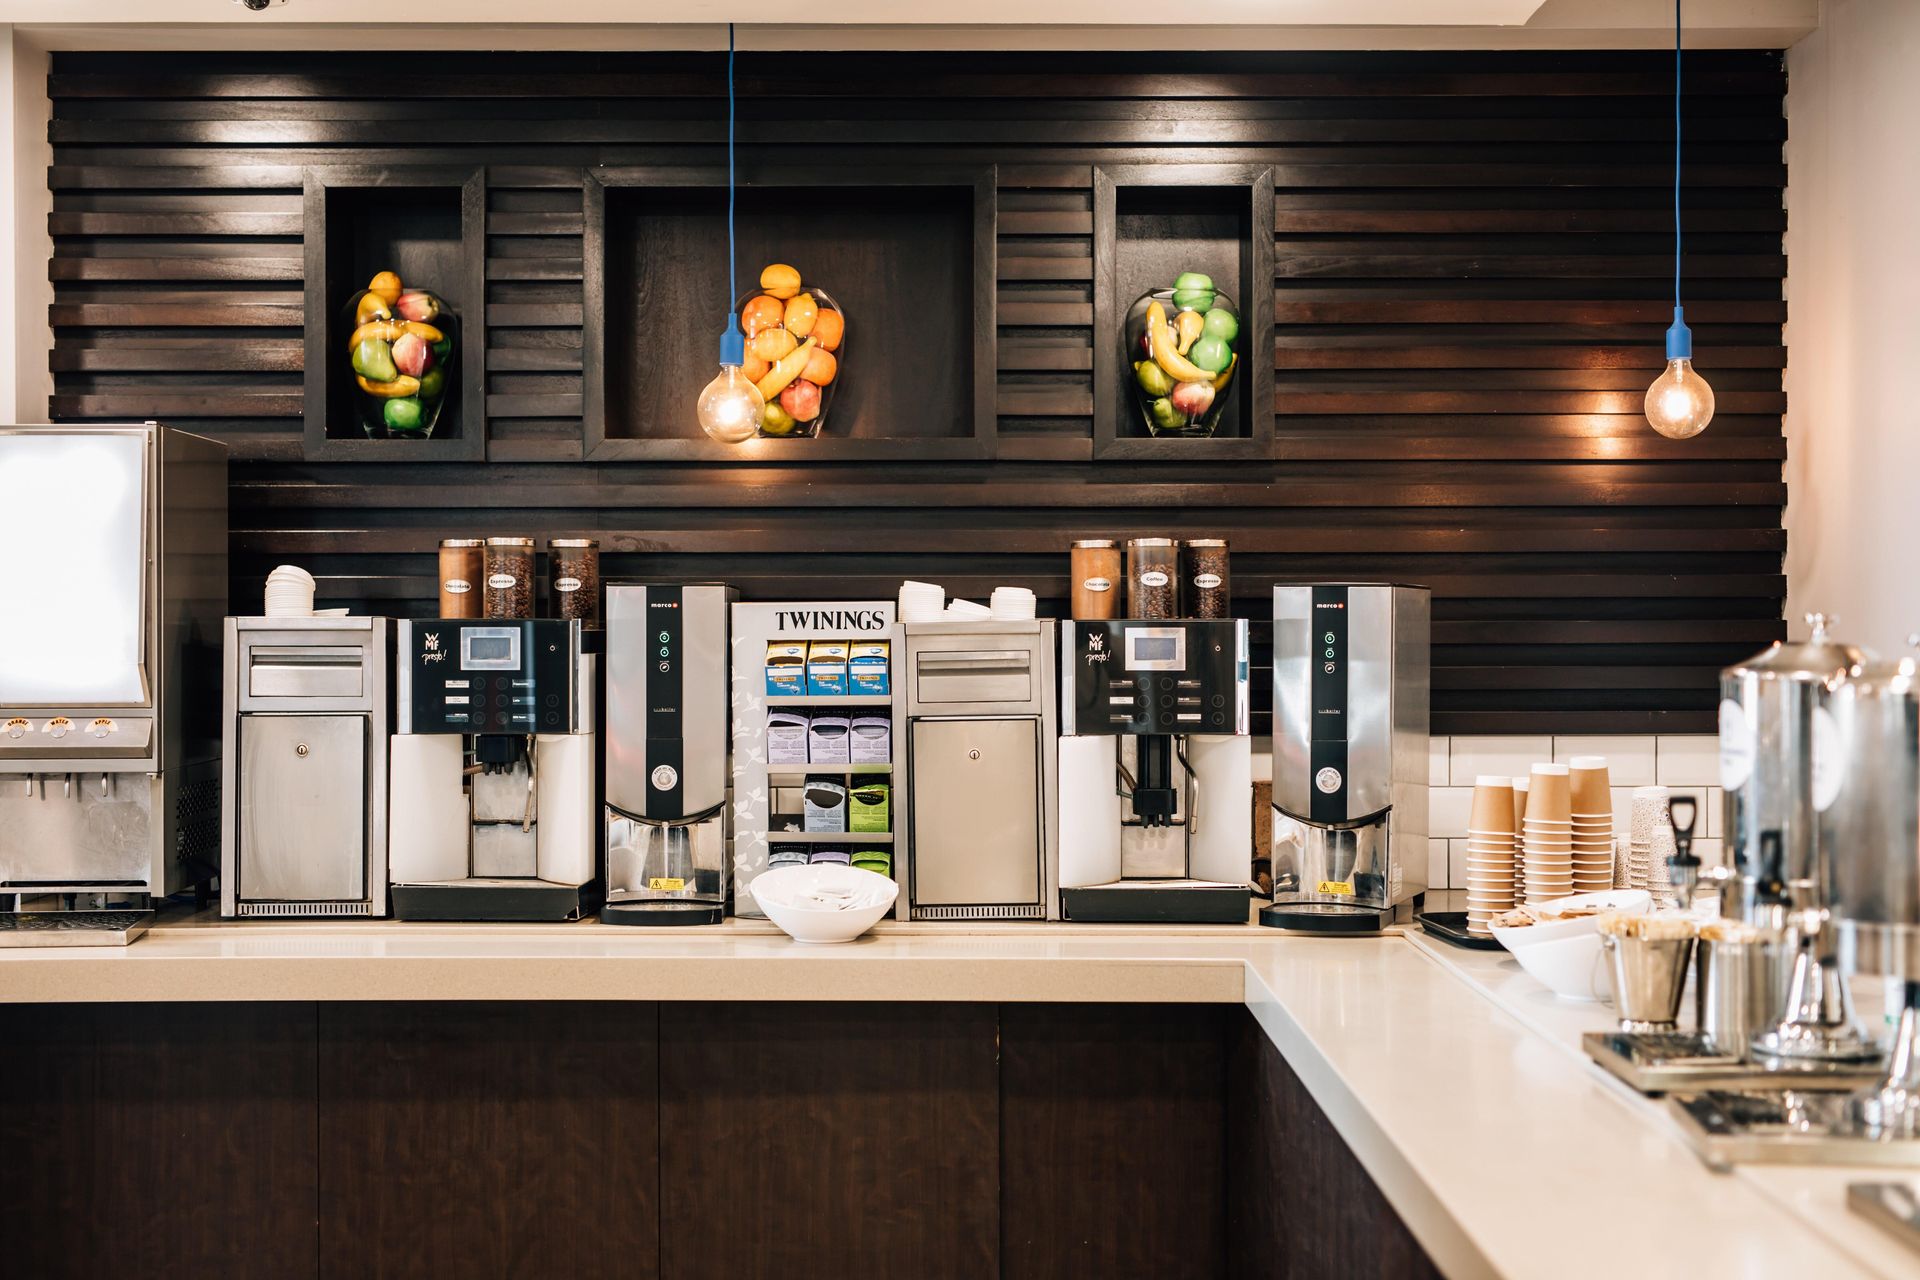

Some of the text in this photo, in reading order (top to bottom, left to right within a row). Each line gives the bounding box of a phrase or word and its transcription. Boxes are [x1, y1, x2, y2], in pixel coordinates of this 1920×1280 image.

[776, 610, 884, 630] TWININGS
[422, 650, 447, 665] presto!
[1085, 650, 1111, 666] presto!
